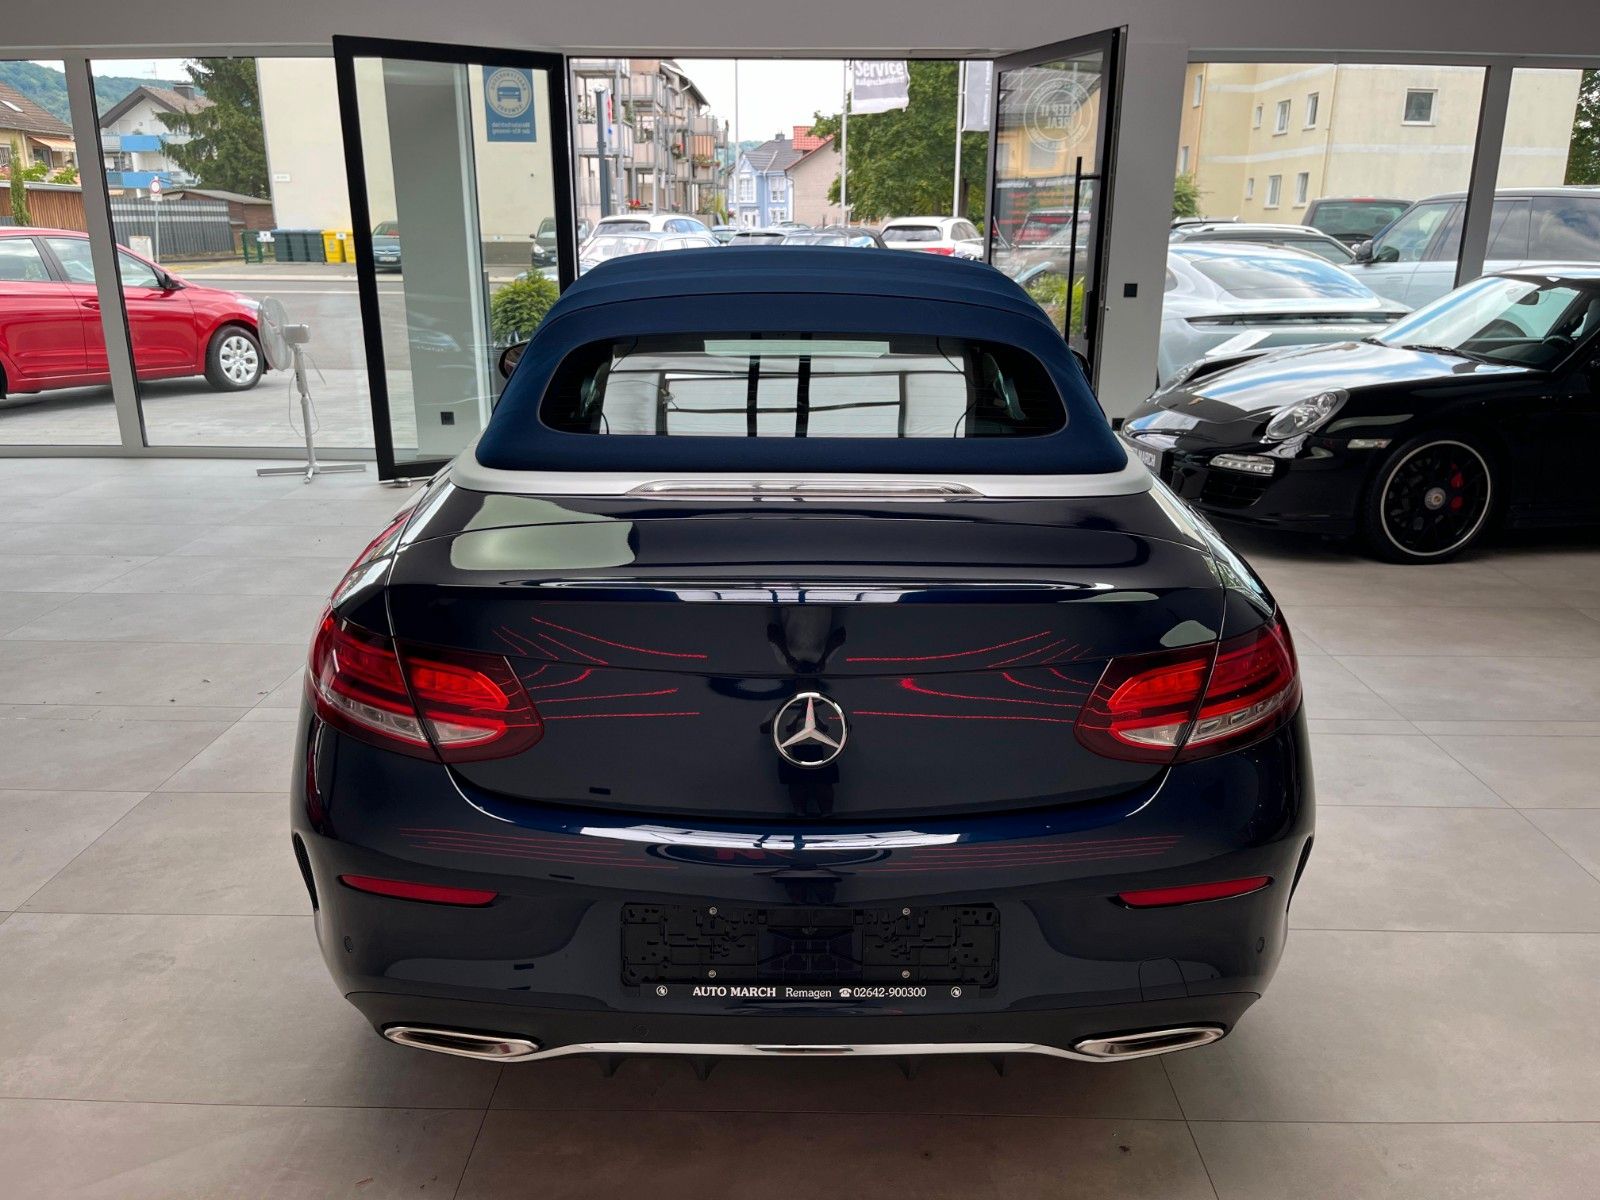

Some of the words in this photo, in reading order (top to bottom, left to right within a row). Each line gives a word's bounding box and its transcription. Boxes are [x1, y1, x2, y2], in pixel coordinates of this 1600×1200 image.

[855, 60, 904, 78] Service
[692, 986, 727, 997] AUTO
[730, 986, 777, 997] MARCH
[785, 987, 832, 1000] Remagen
[853, 987, 927, 998] 02642-900300
